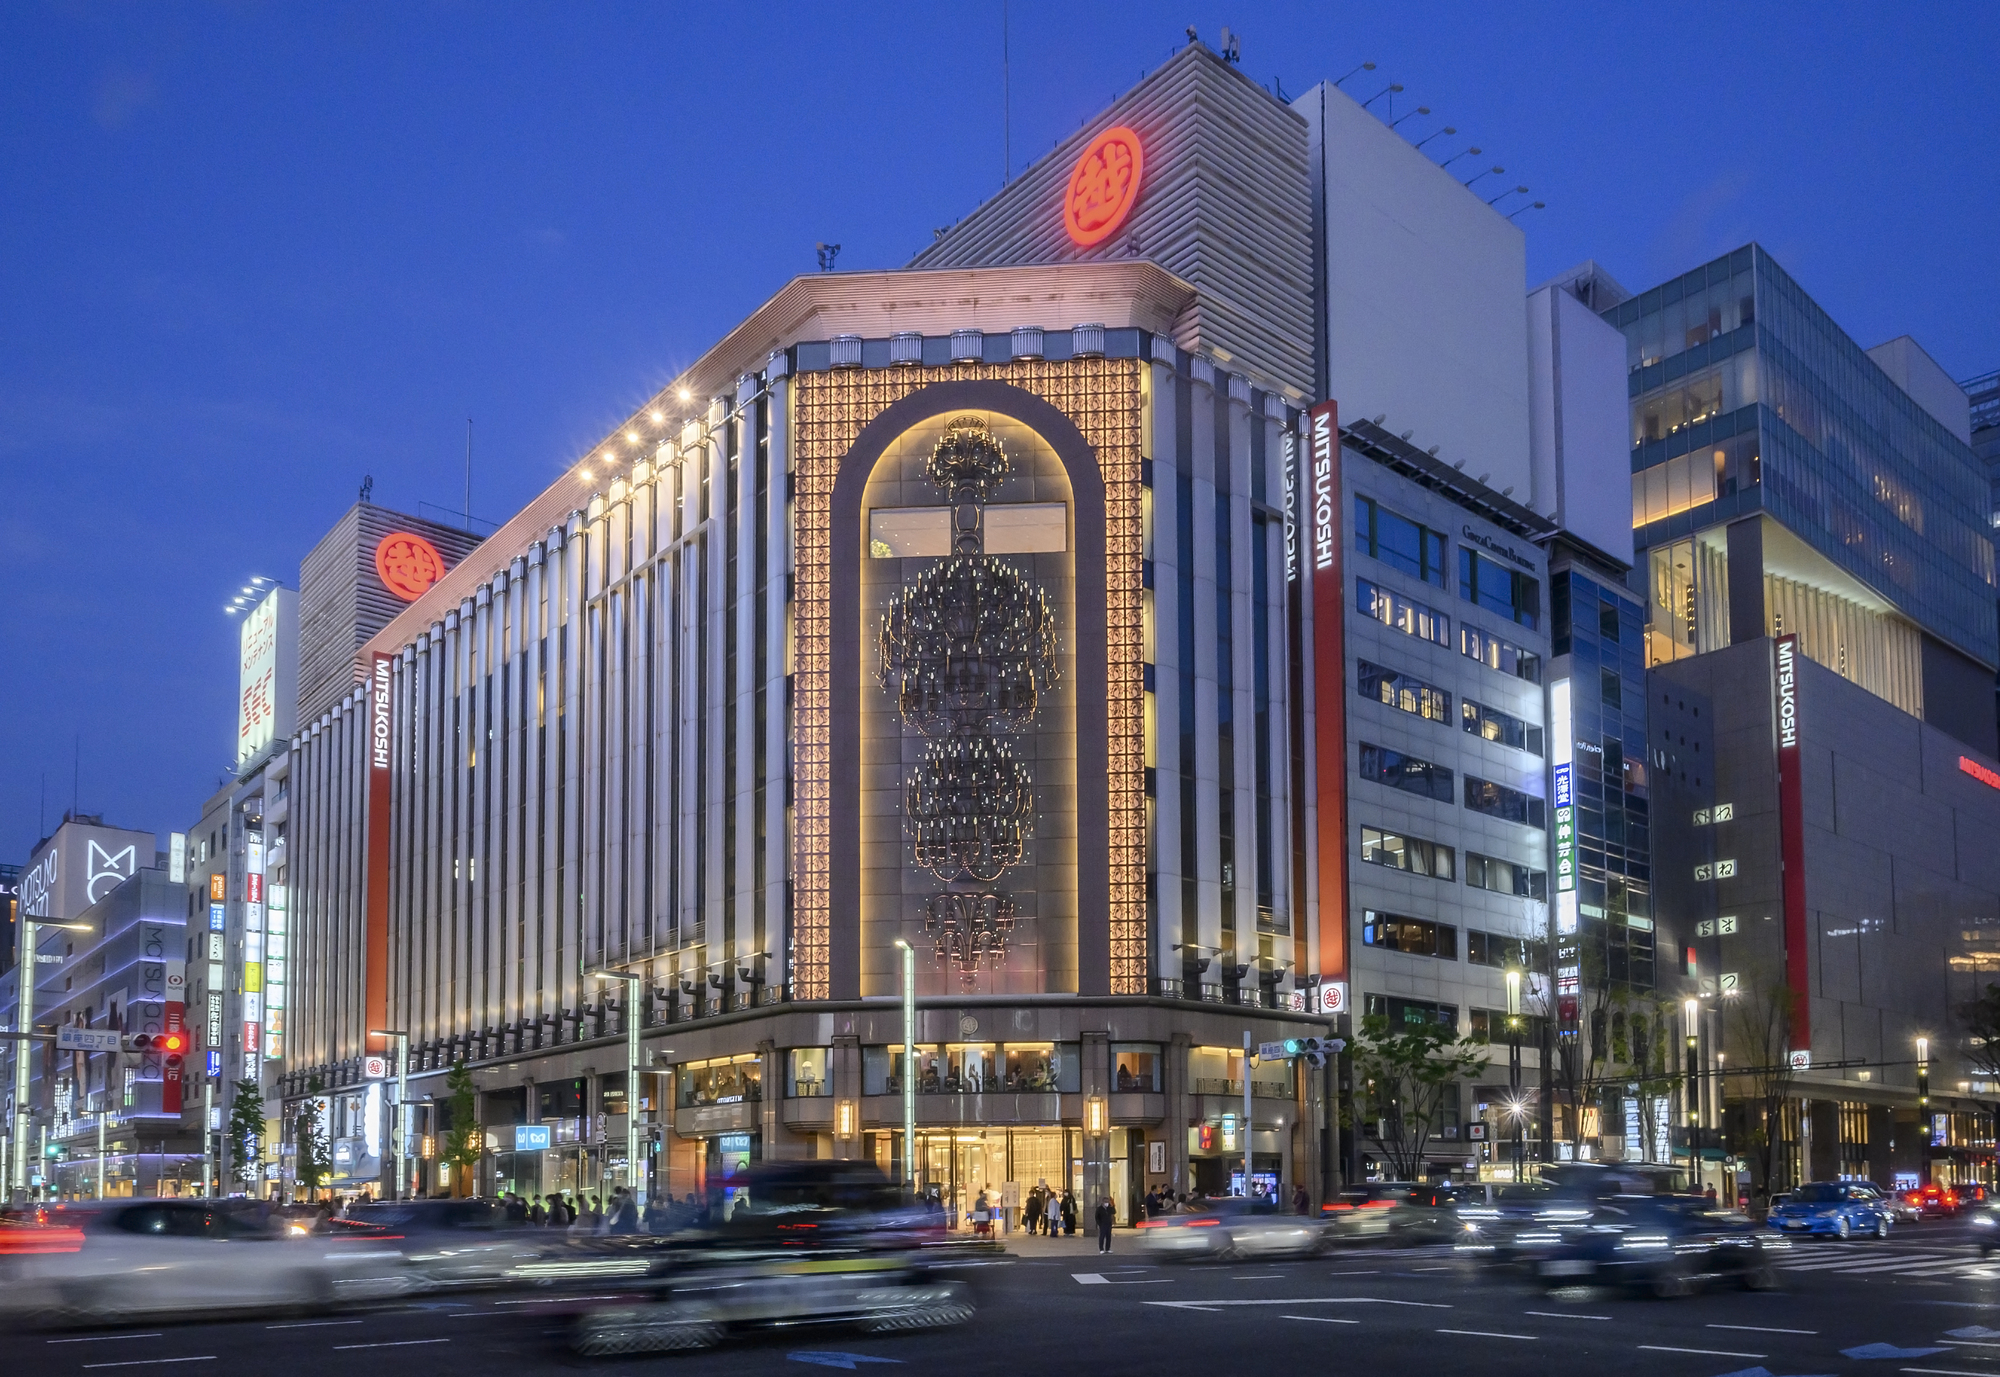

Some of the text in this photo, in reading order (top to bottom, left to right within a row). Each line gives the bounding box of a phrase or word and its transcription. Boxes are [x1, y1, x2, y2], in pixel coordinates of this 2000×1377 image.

[1314, 411, 1333, 570] MITSUKOSHI
[243, 613, 274, 655] リニューアル
[243, 633, 274, 675] メンテナンス
[374, 659, 390, 769] MITSUKOSHI
[1779, 641, 1796, 748] MITSUKOSHI
